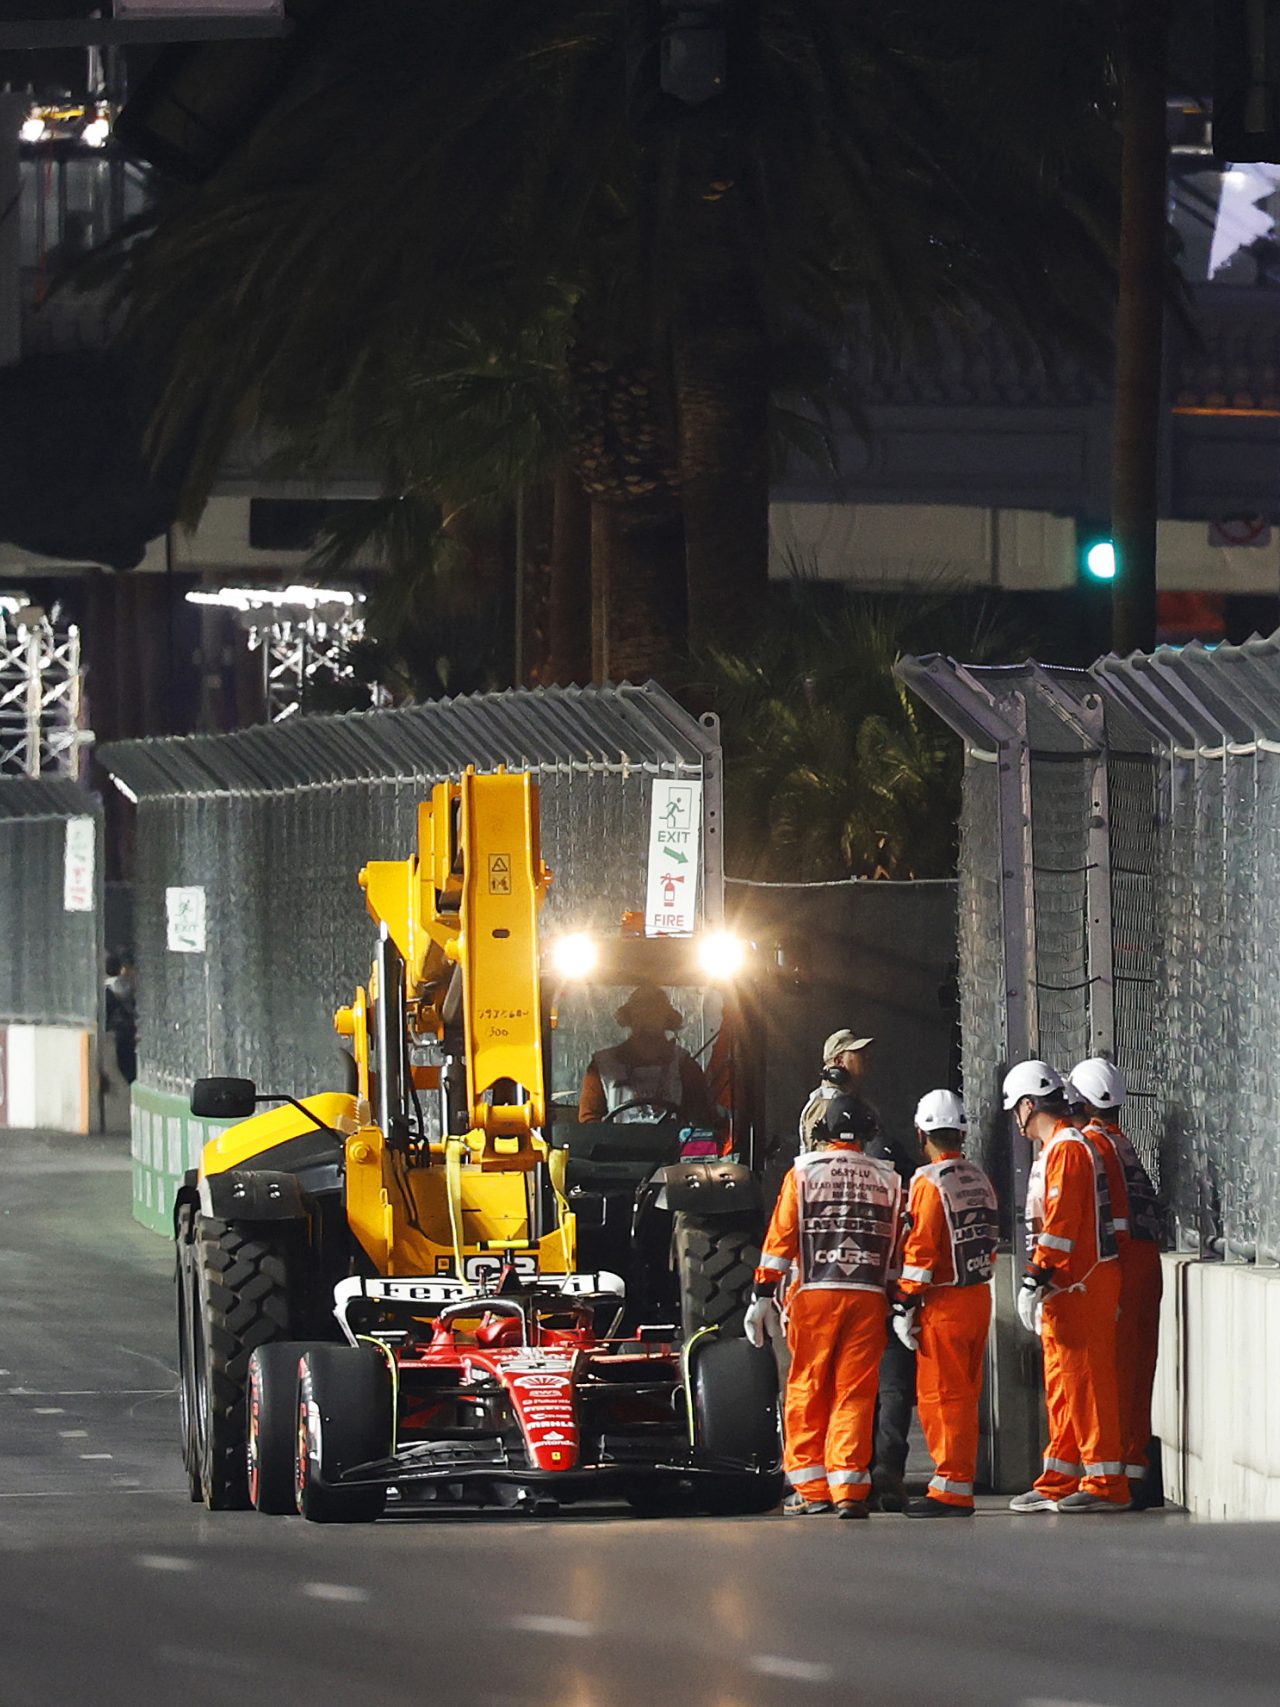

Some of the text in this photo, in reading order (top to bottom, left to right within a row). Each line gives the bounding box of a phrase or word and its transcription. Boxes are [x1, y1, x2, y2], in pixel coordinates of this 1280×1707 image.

[657, 830, 690, 844] EXIT
[654, 913, 684, 927] FIRE
[815, 1248, 880, 1266] COURSE
